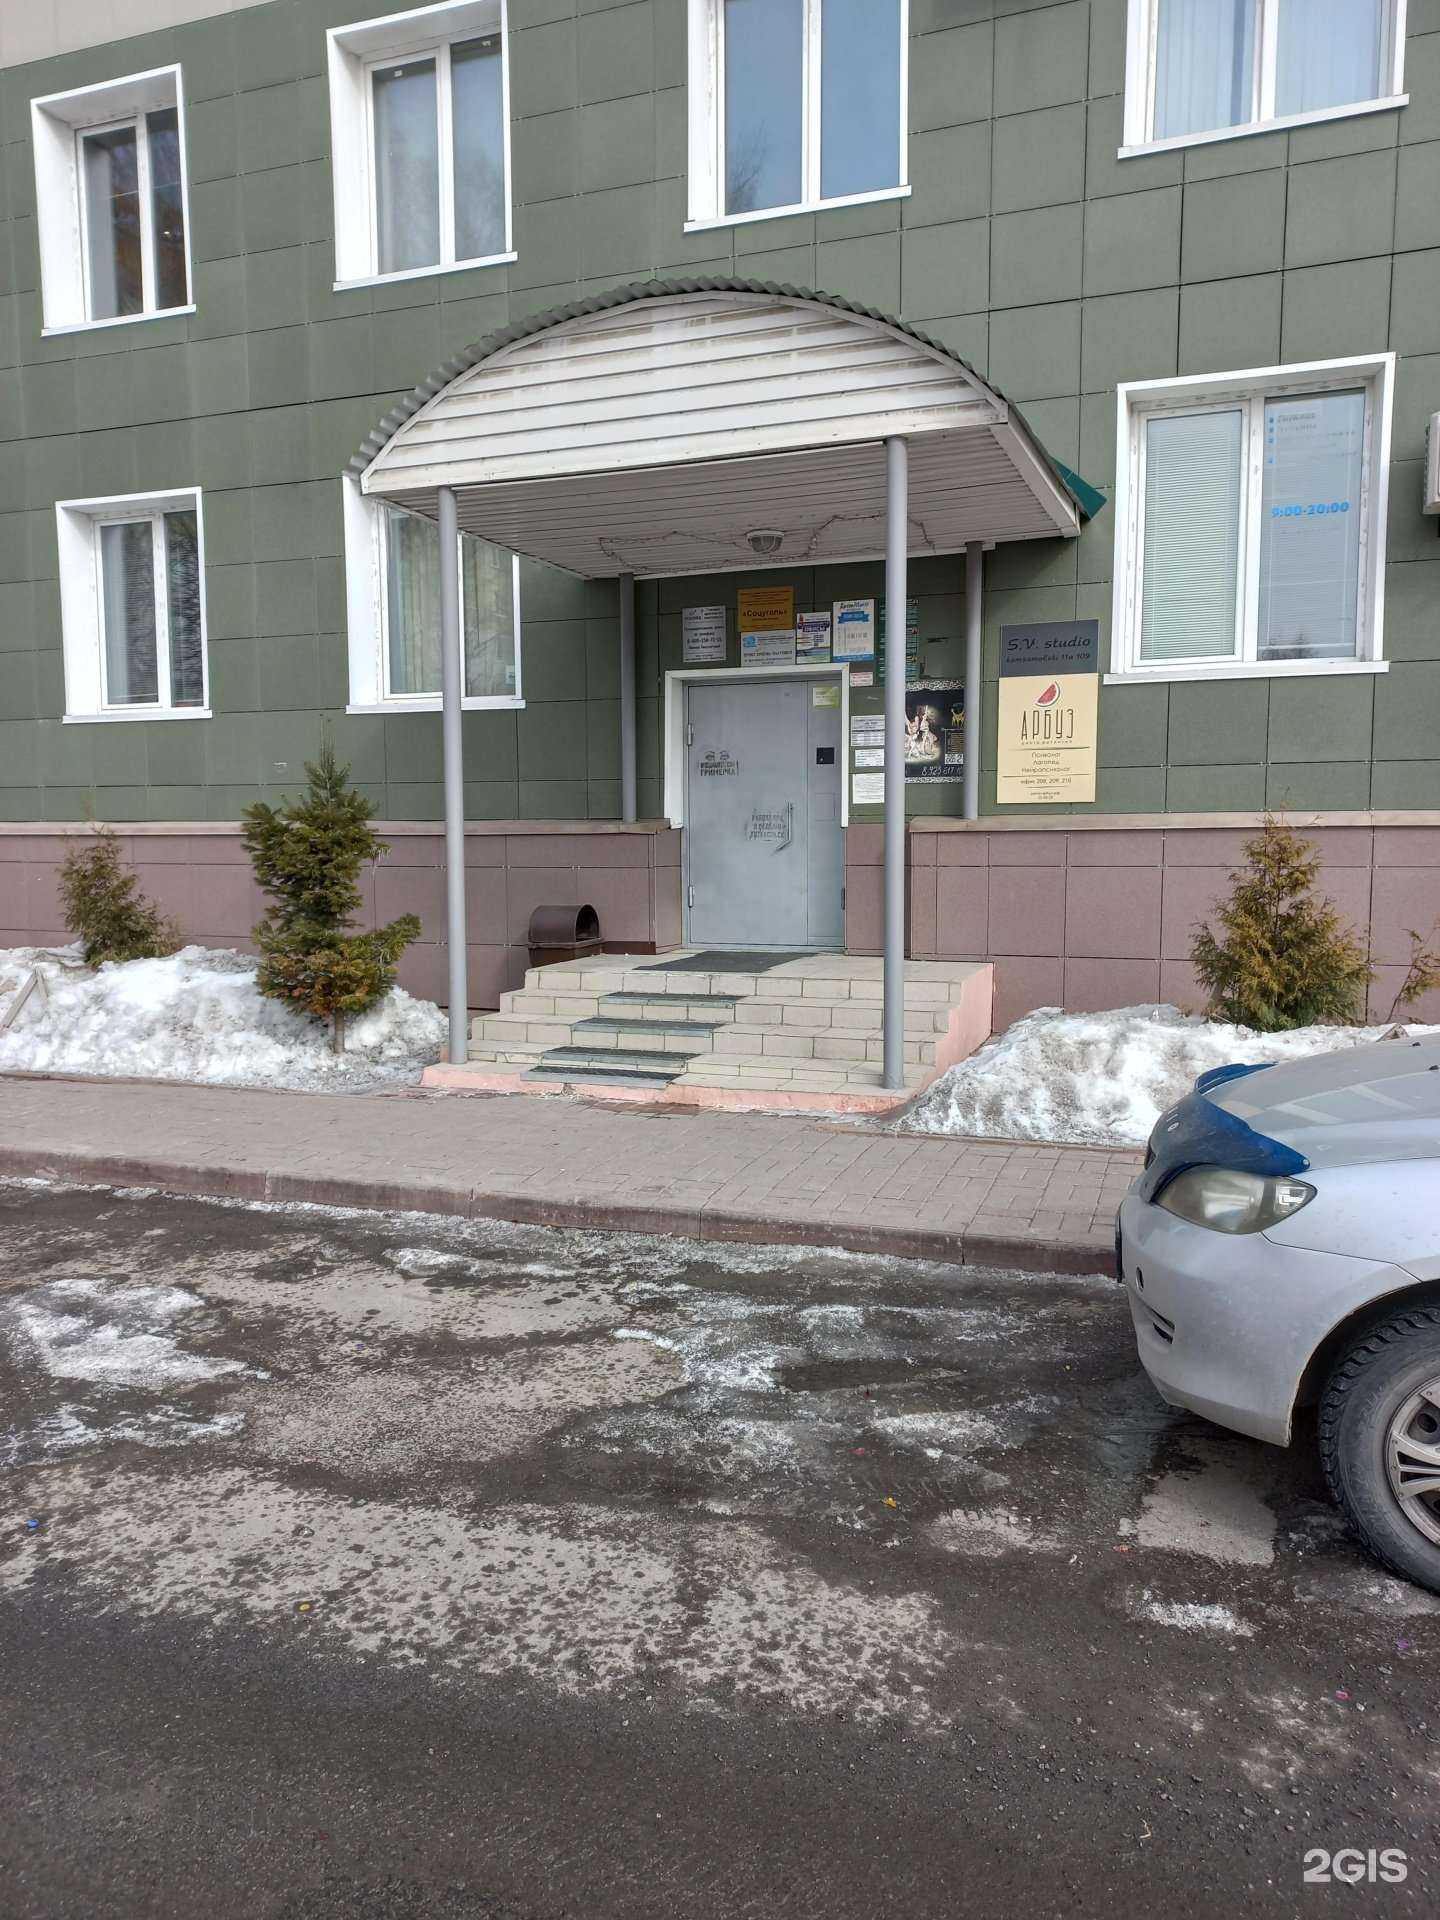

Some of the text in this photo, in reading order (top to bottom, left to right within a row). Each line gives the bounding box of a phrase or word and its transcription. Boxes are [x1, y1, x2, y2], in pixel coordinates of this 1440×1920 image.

[1271, 501, 1350, 518] 9:00-20:00
[1044, 635, 1091, 649] studio
[1020, 708, 1074, 741] АРБУЗ
